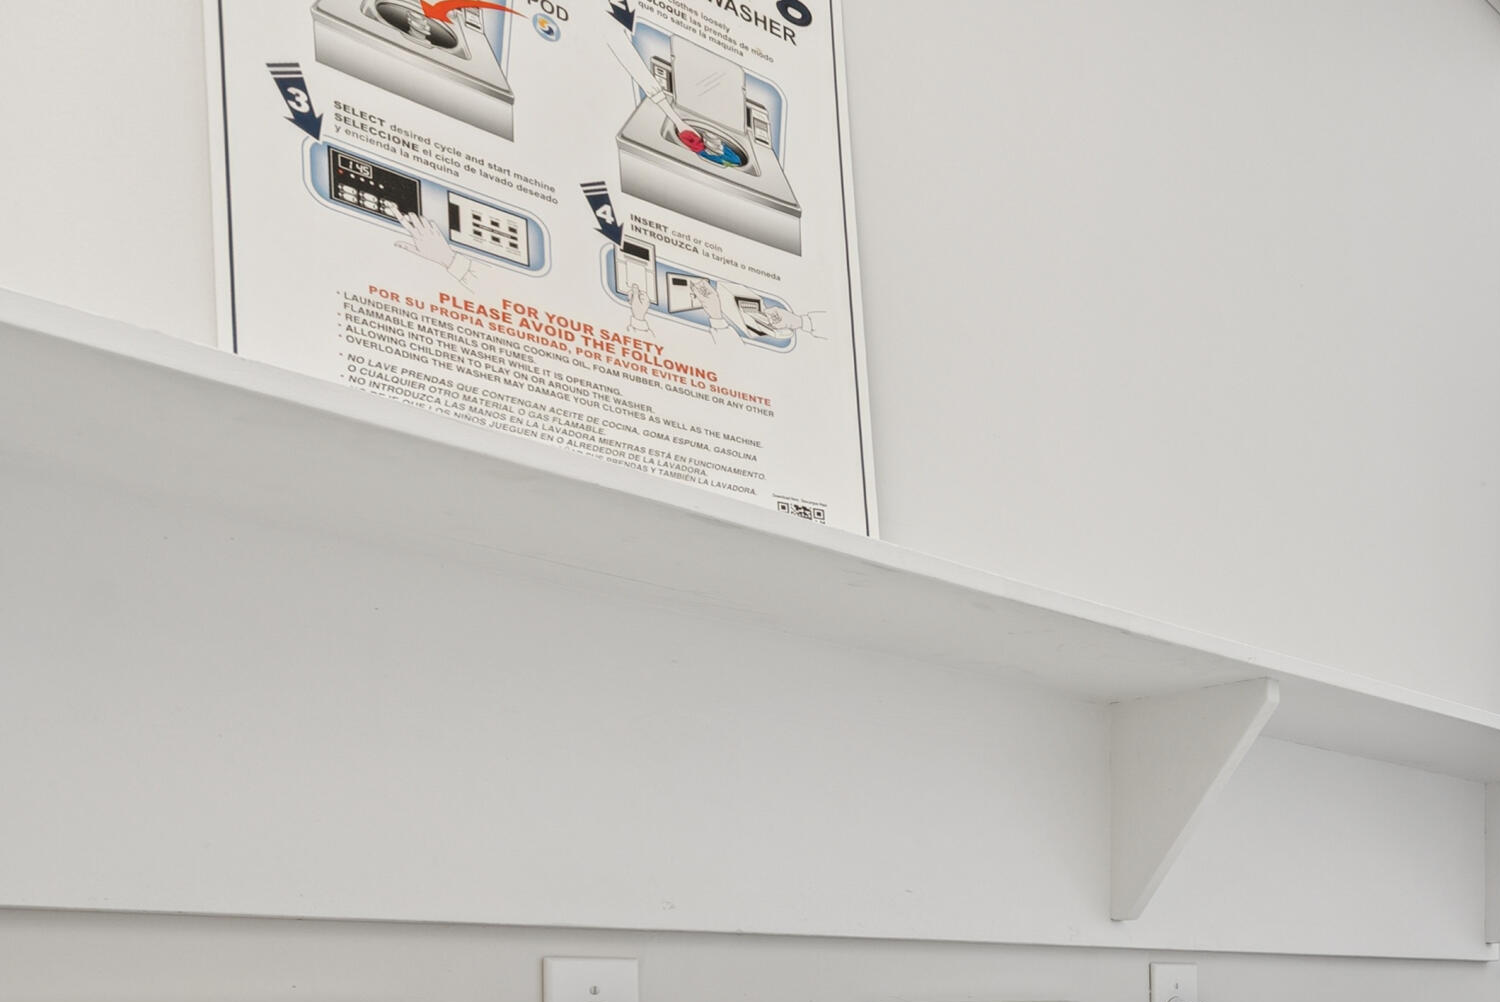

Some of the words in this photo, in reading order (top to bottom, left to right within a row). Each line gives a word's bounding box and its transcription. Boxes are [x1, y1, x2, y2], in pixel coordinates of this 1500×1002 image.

[638, 1, 654, 14] que
[671, 15, 696, 34] sature
[709, 35, 744, 57] maquina
[700, 13, 731, 33] loosely
[704, 20, 737, 46] prendas
[751, 48, 774, 63] modo
[287, 86, 310, 113] 3
[333, 99, 386, 128] SELECT
[389, 123, 430, 146] desired
[433, 139, 462, 159] cycle
[465, 152, 484, 166] and
[487, 161, 510, 176] start
[513, 170, 555, 193] machine
[334, 111, 419, 152] SELECCIONE
[422, 147, 431, 157] el
[434, 151, 460, 168] ciclo
[463, 163, 476, 174] de
[479, 168, 513, 188] lavado
[516, 183, 558, 205] deseado
[344, 127, 396, 154] encienda
[399, 147, 409, 159] la
[412, 153, 459, 178] maquina
[596, 204, 614, 225] 4
[630, 212, 668, 234] INSERT
[671, 228, 690, 241] card
[693, 237, 702, 246] or
[704, 240, 722, 253] coin
[631, 222, 698, 255] INTRODUZCA
[702, 249, 709, 258] la
[711, 251, 738, 269] tarjeta
[747, 263, 781, 283] moneda
[343, 301, 413, 329] FLAMMABLE
[417, 323, 477, 347] MATERIALS
[481, 341, 496, 353] OR
[499, 346, 535, 364] FUMES.
[343, 291, 417, 321] LAUNDERING
[421, 314, 453, 331] ITEMS
[457, 325, 520, 350] CONTAINING
[523, 344, 569, 364] COOKING
[592, 363, 619, 377] FOAM
[664, 383, 709, 401] GASOLINE
[711, 395, 724, 405] OR
[726, 399, 743, 410] ANY
[745, 404, 774, 418] OTHER
[345, 313, 404, 337] REACHING
[407, 330, 433, 345] INTO
[436, 339, 457, 352] THE
[460, 345, 505, 365] WASHER
[508, 359, 540, 374] WHILE
[542, 368, 550, 377] IT
[553, 371, 562, 381] IS
[565, 374, 622, 396] OPERATING.
[368, 284, 399, 303] POR
[404, 295, 425, 311] SU
[430, 303, 483, 328] PROPIA
[494, 322, 571, 353] SEGURIDAD,
[575, 346, 601, 362] POR
[606, 355, 647, 374] FAVOR
[651, 367, 687, 385] EVITE
[690, 378, 705, 390] LO
[709, 383, 771, 407] SIGUIENTE
[438, 291, 512, 325] PLEASE
[518, 315, 575, 343] AVOID
[580, 334, 615, 355] THE
[621, 346, 717, 383] FOLLOWING
[501, 298, 539, 320] FOR
[545, 311, 593, 337] YOUR
[599, 328, 664, 357] SAFETY
[345, 324, 406, 348] ALLOWING
[409, 341, 464, 364] CHILDREN
[467, 357, 481, 369] TO
[484, 362, 509, 376] PLAY
[513, 370, 527, 381] ON
[530, 374, 545, 385] OR
[547, 379, 589, 397] AROUND
[593, 391, 610, 402] THE
[613, 396, 654, 414] WASHER.
[345, 334, 428, 364] OVERLOADING
[431, 358, 453, 371] THE
[456, 364, 500, 383] WASHER
[503, 377, 523, 389] MAY
[527, 383, 570, 401] DAMAGE
[573, 395, 599, 409] YOUR
[602, 402, 645, 420] CLOTHES
[648, 414, 660, 424] AS
[663, 418, 687, 431] WELL
[689, 425, 701, 434] AS
[704, 428, 720, 438] THE
[359, 366, 425, 391] CUALQUIER
[428, 384, 459, 399] OTRO
[462, 393, 514, 413] MATERIAL
[528, 410, 549, 422] GAS
[367, 358, 397, 373] LAVE
[400, 367, 453, 388] PRENDAS
[456, 382, 478, 394] QUE
[481, 388, 546, 412] CONTENGAN
[548, 405, 583, 421] ACEITE
[642, 429, 669, 442] GOMA
[713, 446, 757, 461] GASOLINA
[368, 380, 441, 405] INTRODUZCA
[444, 399, 465, 411] LAS
[468, 405, 506, 421] MANOS
[541, 423, 595, 442] LAVADORA
[598, 436, 646, 454] MIENTRAS
[489, 420, 536, 438] JUEGUEN
[566, 438, 625, 458] ALREDEDOR
